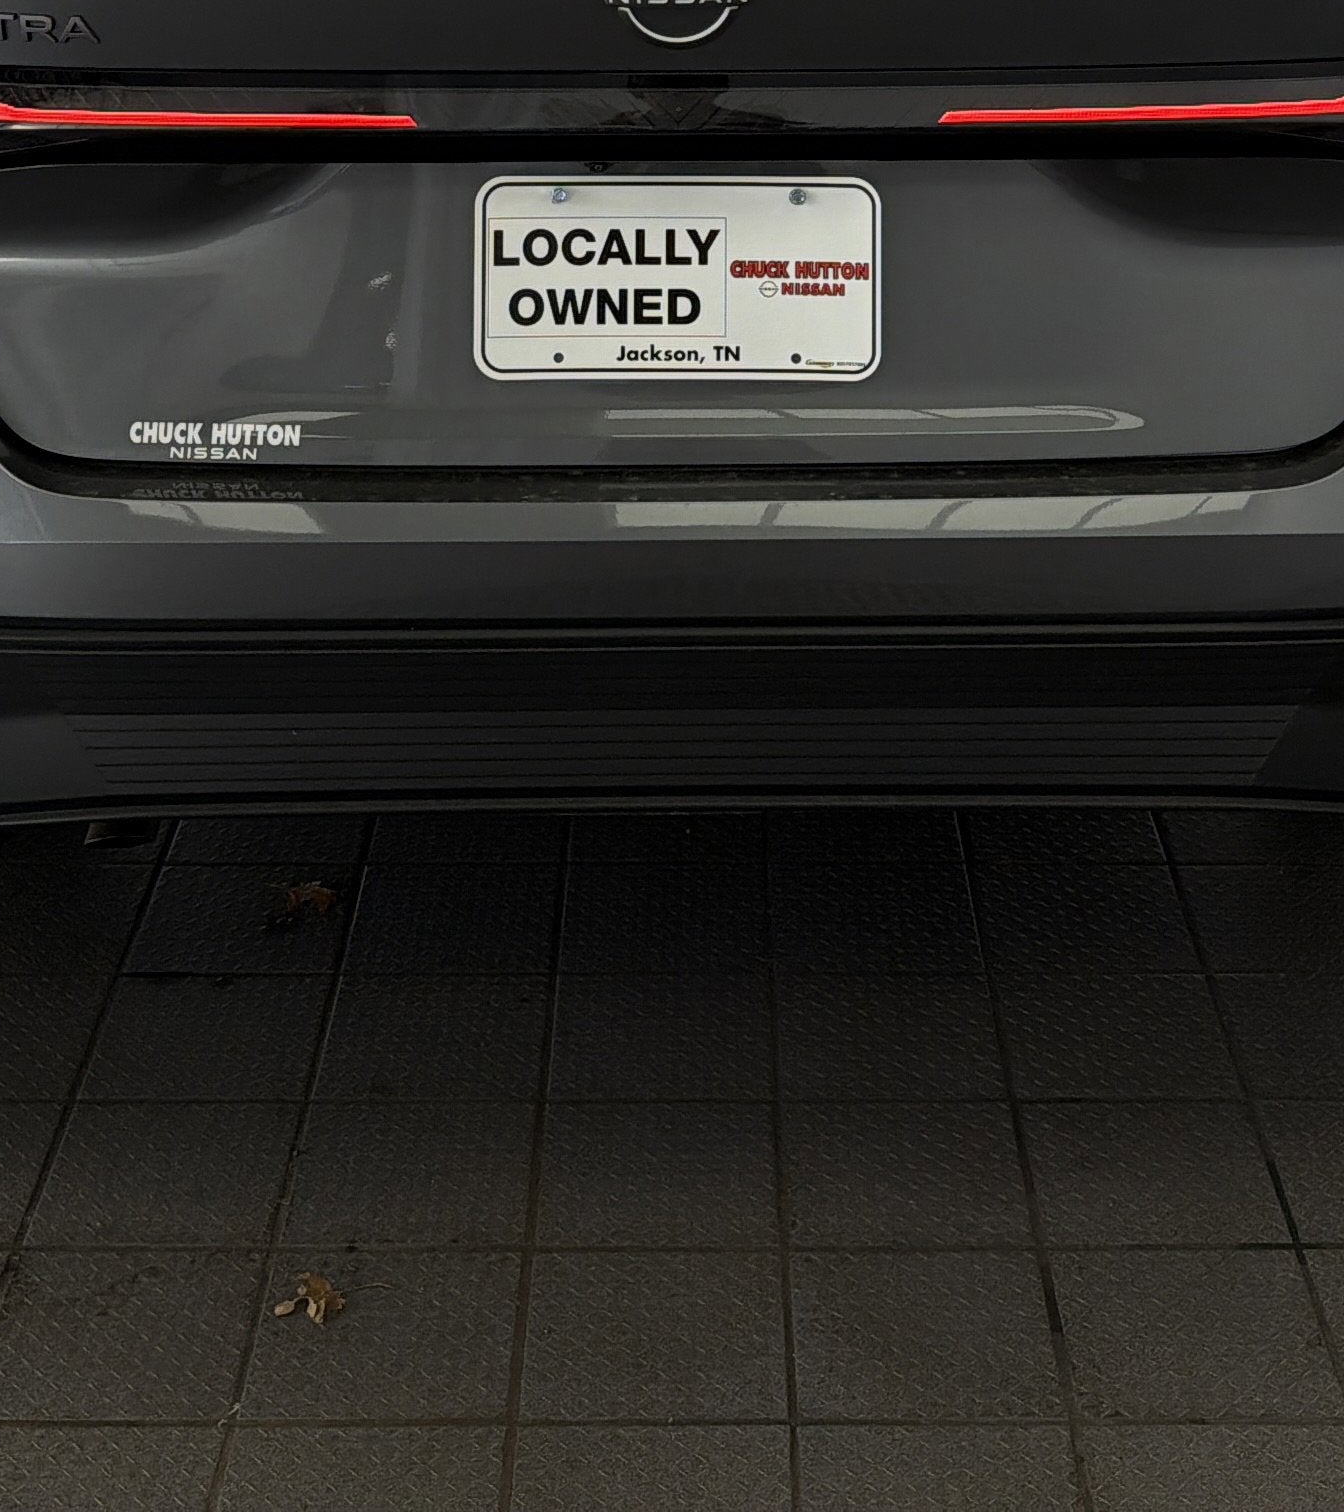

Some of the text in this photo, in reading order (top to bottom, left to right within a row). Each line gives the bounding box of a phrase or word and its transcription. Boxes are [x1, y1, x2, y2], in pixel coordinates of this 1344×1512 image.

[493, 228, 720, 266] LOCALLY
[730, 260, 870, 280] CHUCK HUTTON
[781, 282, 845, 296] NISSAN
[508, 288, 701, 325] OWNED
[616, 344, 741, 363] Jackson, TN
[129, 421, 301, 446] CHUCK HUTTON
[169, 446, 258, 460] NISSAN
